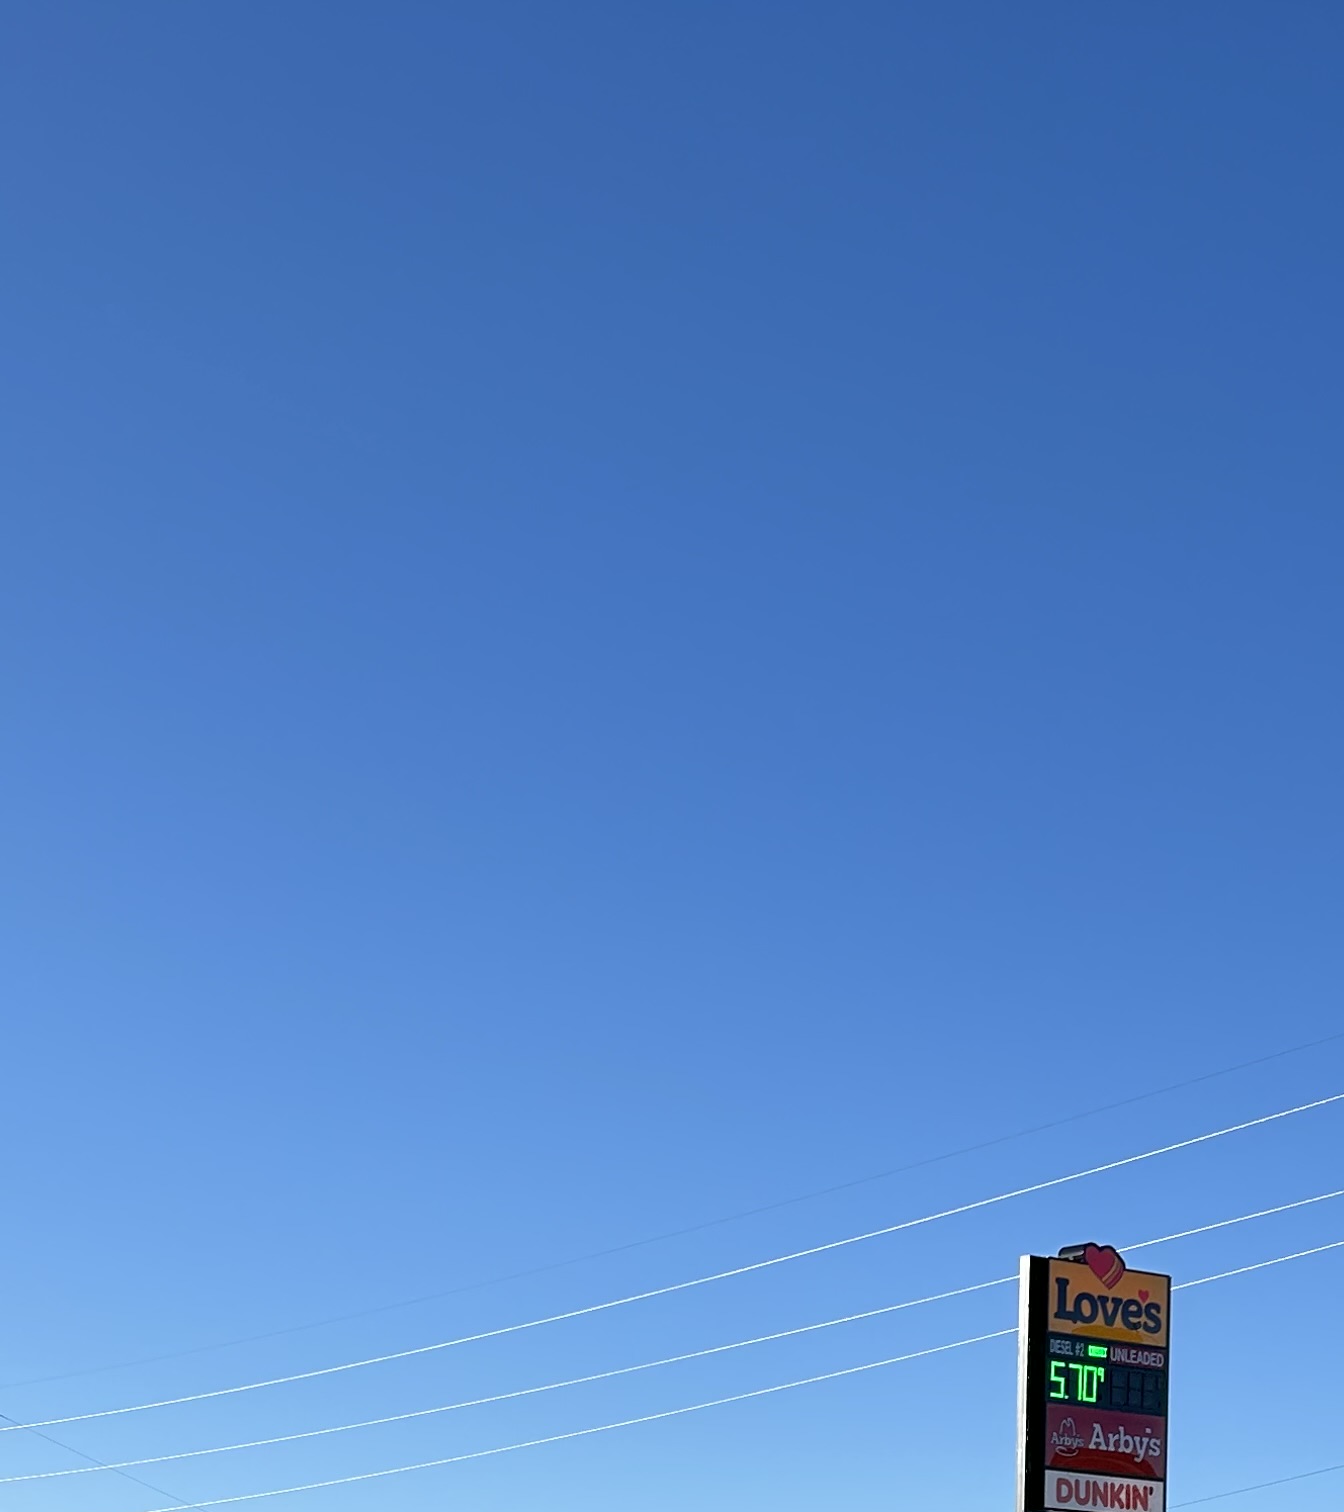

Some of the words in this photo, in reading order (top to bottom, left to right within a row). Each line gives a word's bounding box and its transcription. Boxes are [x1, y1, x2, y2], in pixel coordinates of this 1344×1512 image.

[1050, 1339, 1074, 1356] DIESEL
[1075, 1342, 1085, 1358] #2
[1110, 1346, 1165, 1367] UNLEADED
[1050, 1431, 1085, 1451] Arby's
[1088, 1423, 1161, 1463] Arby's
[1056, 1477, 1154, 1512] DUNKIN'
